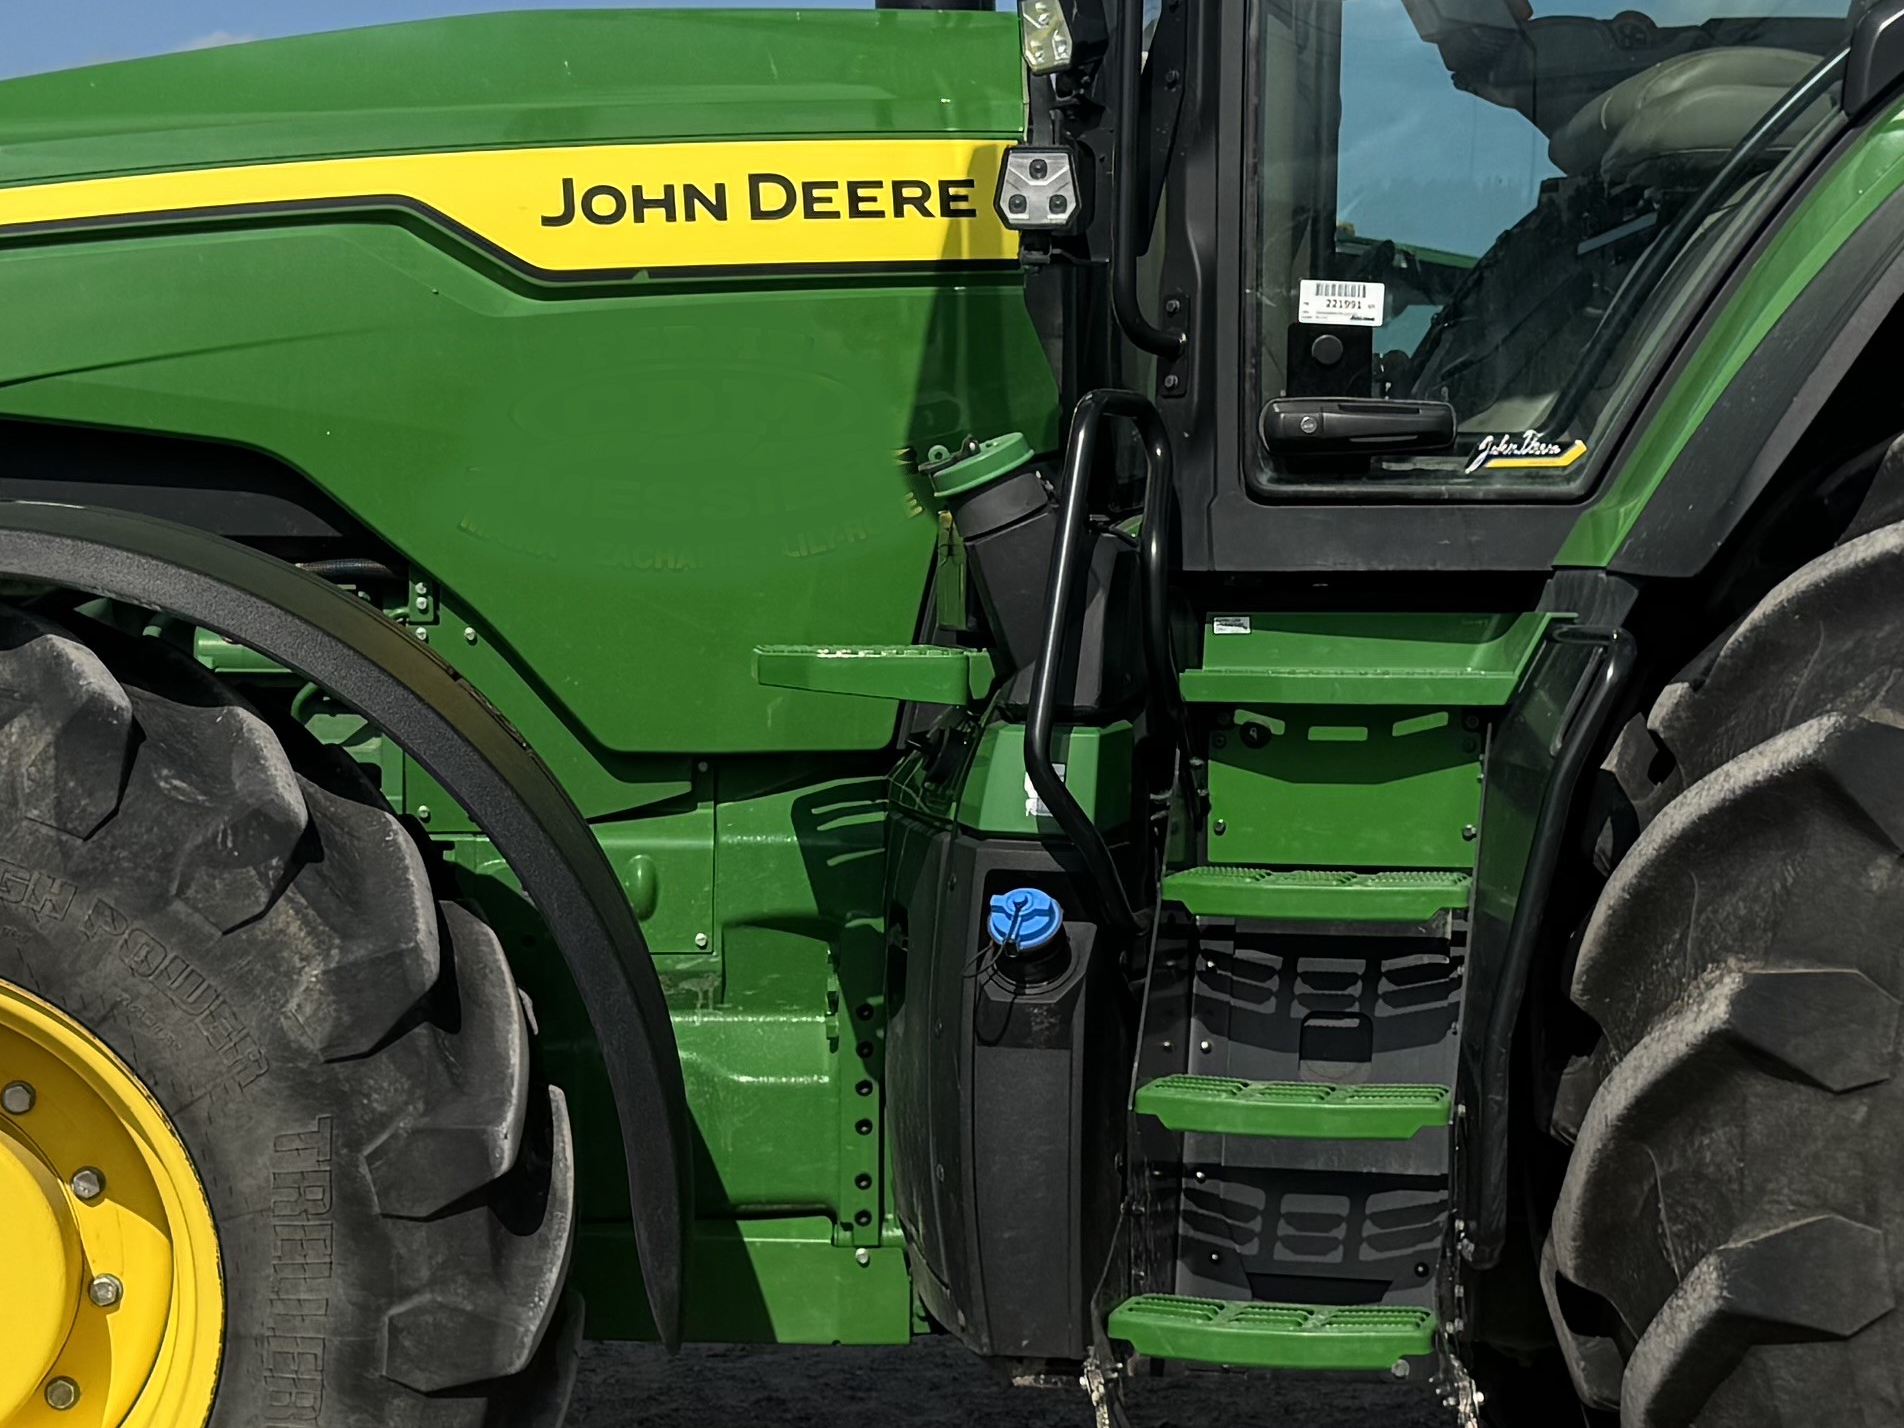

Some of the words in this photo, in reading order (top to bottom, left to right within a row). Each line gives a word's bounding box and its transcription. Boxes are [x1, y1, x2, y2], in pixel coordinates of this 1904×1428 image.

[541, 176, 728, 228] JOHN
[748, 172, 977, 222] DEERE
[82, 895, 272, 1092] POWER
